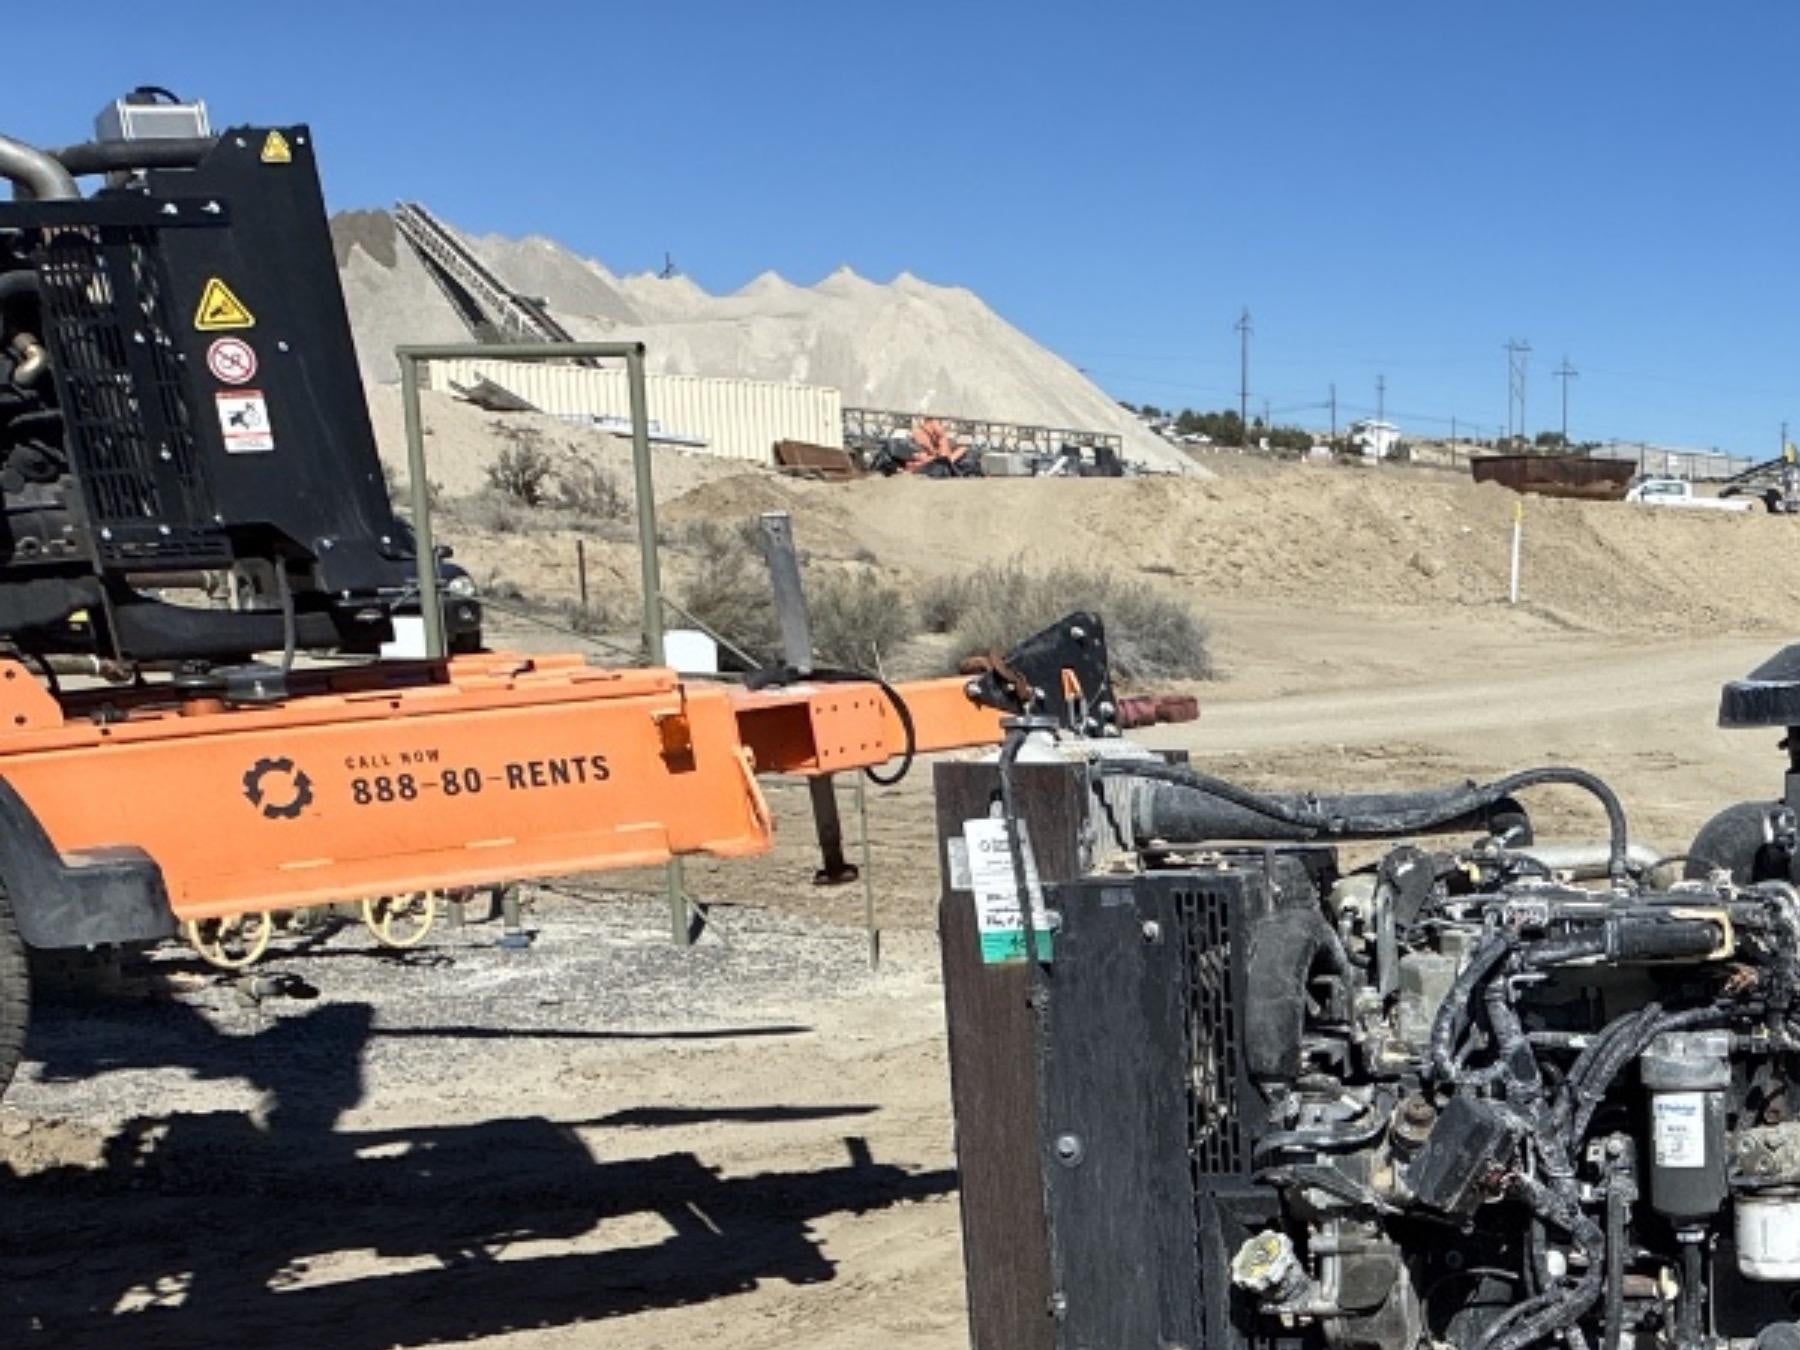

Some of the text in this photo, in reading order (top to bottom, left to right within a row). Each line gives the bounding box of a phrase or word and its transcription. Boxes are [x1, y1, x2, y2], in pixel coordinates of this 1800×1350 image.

[344, 749, 440, 770] CALL NOW
[350, 754, 611, 806] 888-80-RENTS
